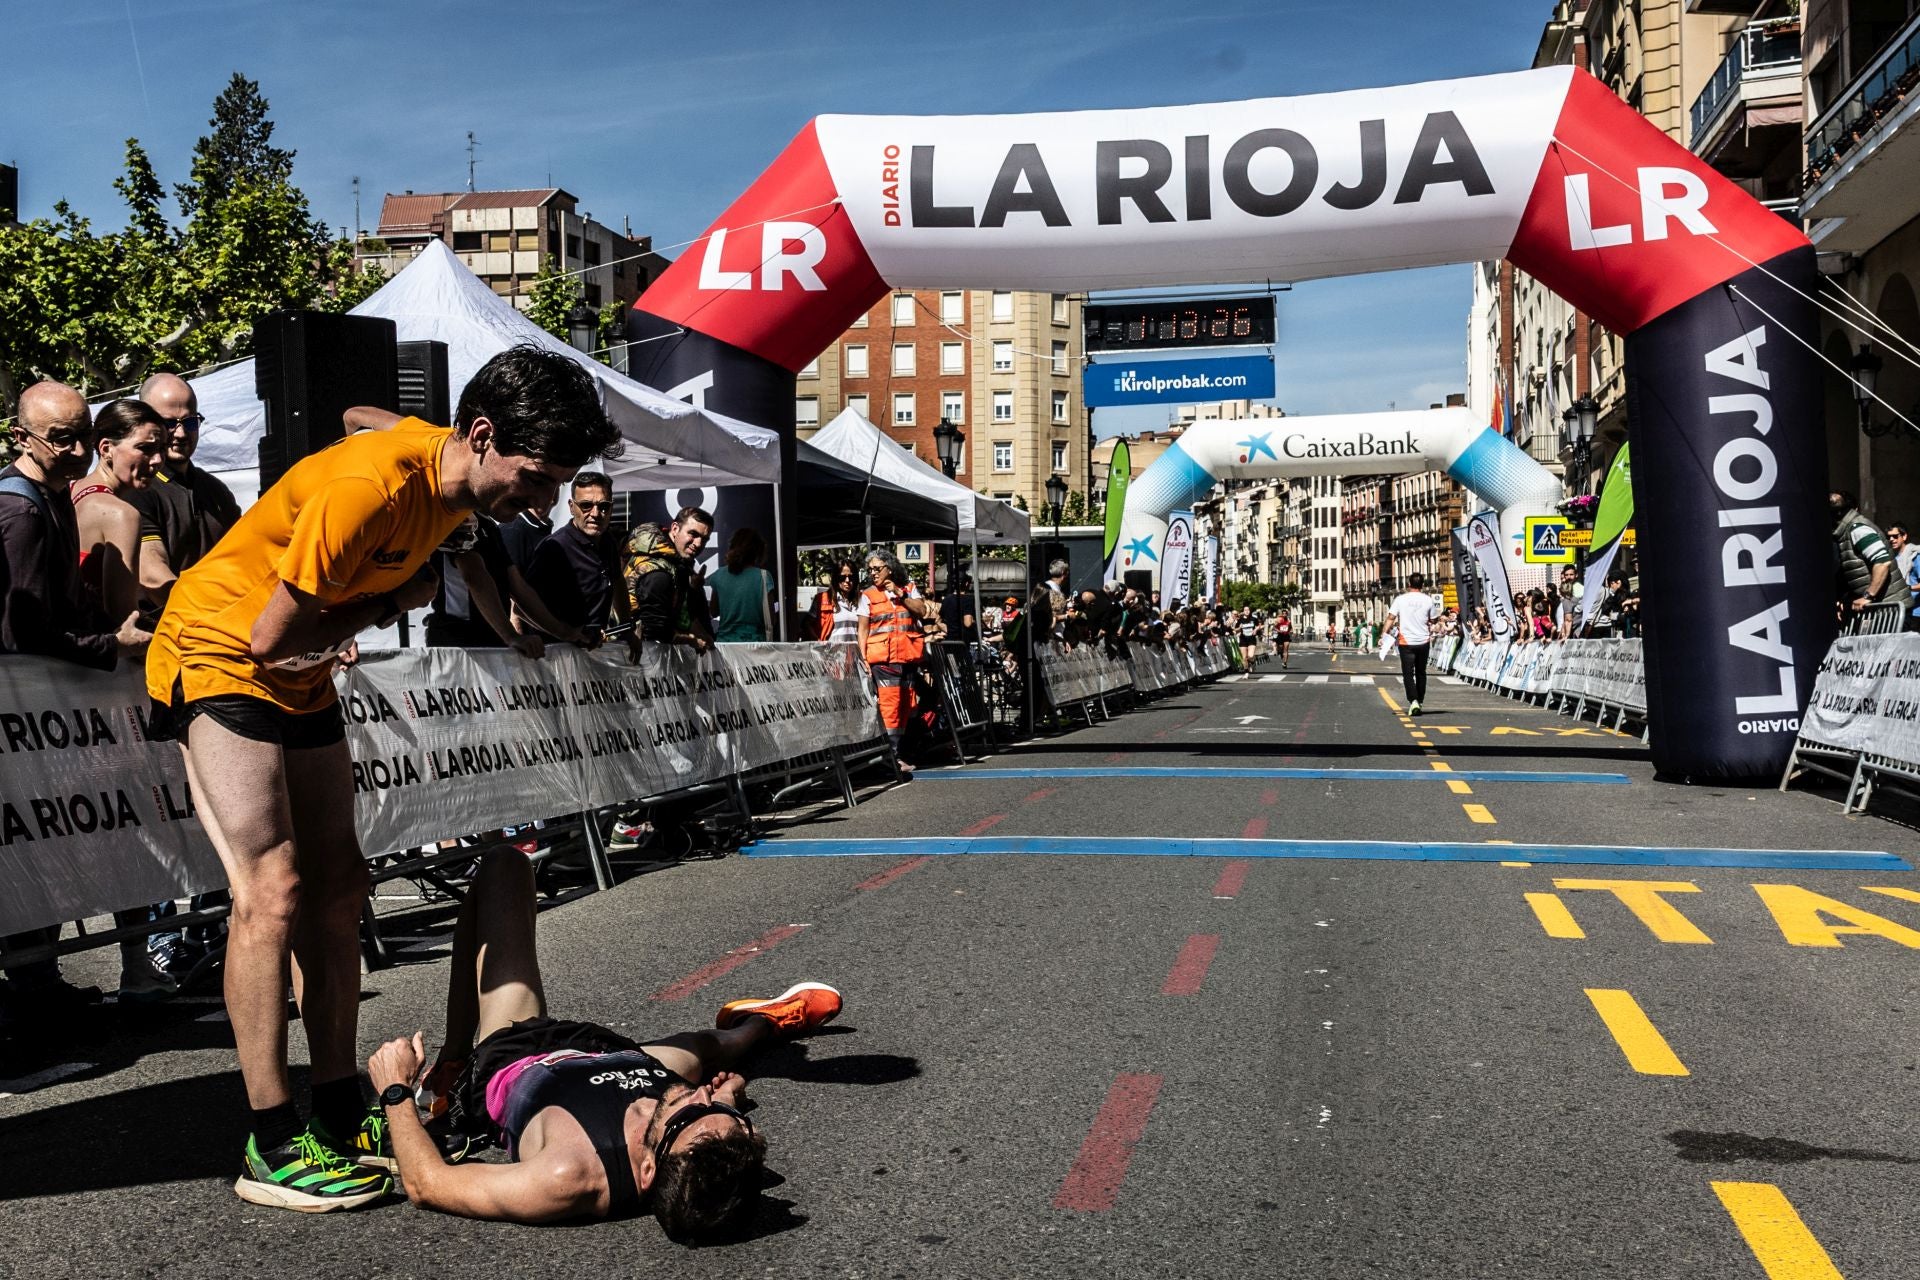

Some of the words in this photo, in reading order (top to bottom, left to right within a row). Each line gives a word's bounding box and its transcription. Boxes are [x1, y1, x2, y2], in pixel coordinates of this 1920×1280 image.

[883, 145, 900, 227] DIARIO
[910, 142, 1072, 228] LA
[1096, 110, 1496, 225] RIOJA
[1564, 166, 1719, 250] LR
[699, 221, 827, 291] LR
[1121, 374, 1247, 393] Kirolprobak.com
[1283, 430, 1421, 458] CaixaBank
[1704, 325, 1786, 587] RIOJA
[1729, 600, 1799, 714] LA
[340, 693, 399, 725] IOJA
[1738, 718, 1799, 734] DIARIO
[459, 742, 516, 776] RIOJA
[30, 789, 141, 839] RIOJA
